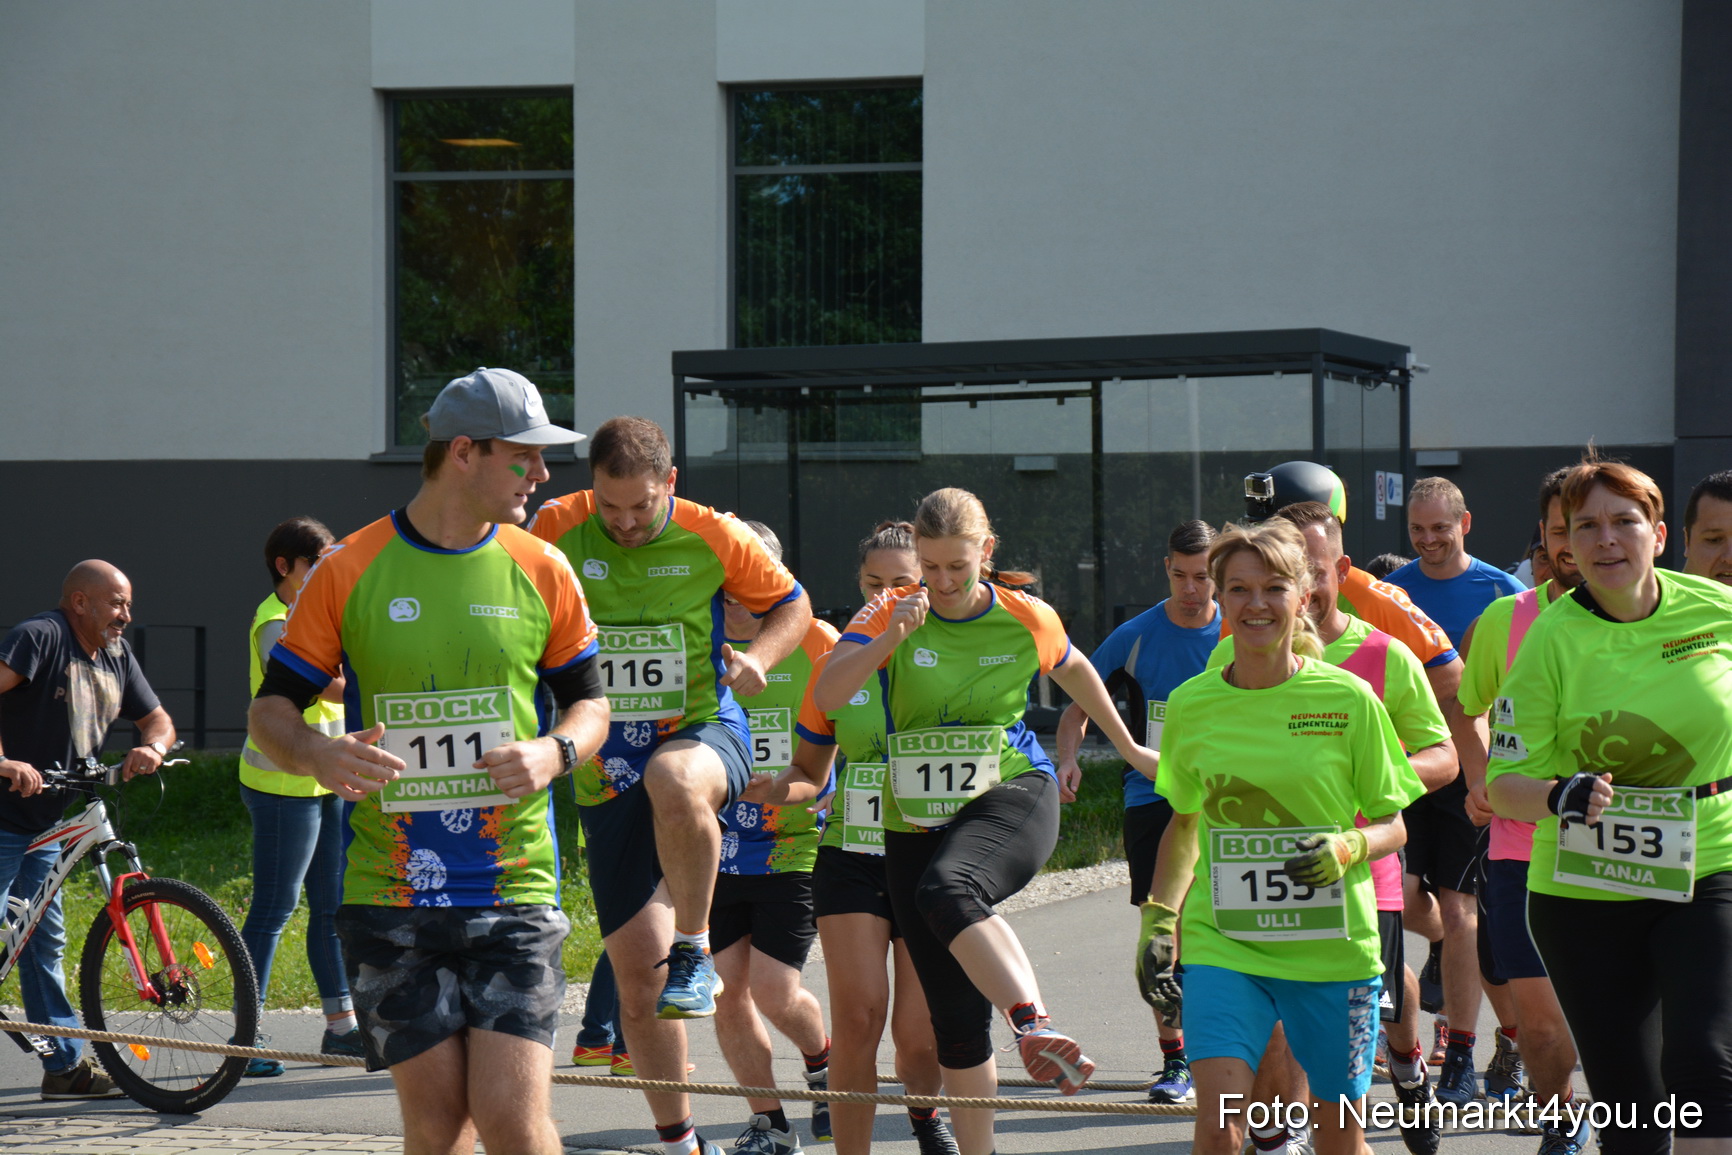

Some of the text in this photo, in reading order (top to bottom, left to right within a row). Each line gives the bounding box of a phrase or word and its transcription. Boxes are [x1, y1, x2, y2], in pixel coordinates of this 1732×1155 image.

[648, 565, 690, 577] BOCK
[470, 604, 519, 619] BOCK
[979, 655, 1017, 666] BOCK
[600, 659, 664, 687] 116
[766, 673, 792, 682] OCK
[386, 692, 502, 726] BOCK
[408, 732, 483, 769] 111
[898, 731, 993, 754] BOCK
[916, 762, 977, 792] 112
[858, 830, 885, 843] VIK
[1590, 821, 1664, 859] 153
[1680, 830, 1692, 838] E6
[1591, 860, 1657, 884] TANJA
[1257, 913, 1302, 928] ULLI
